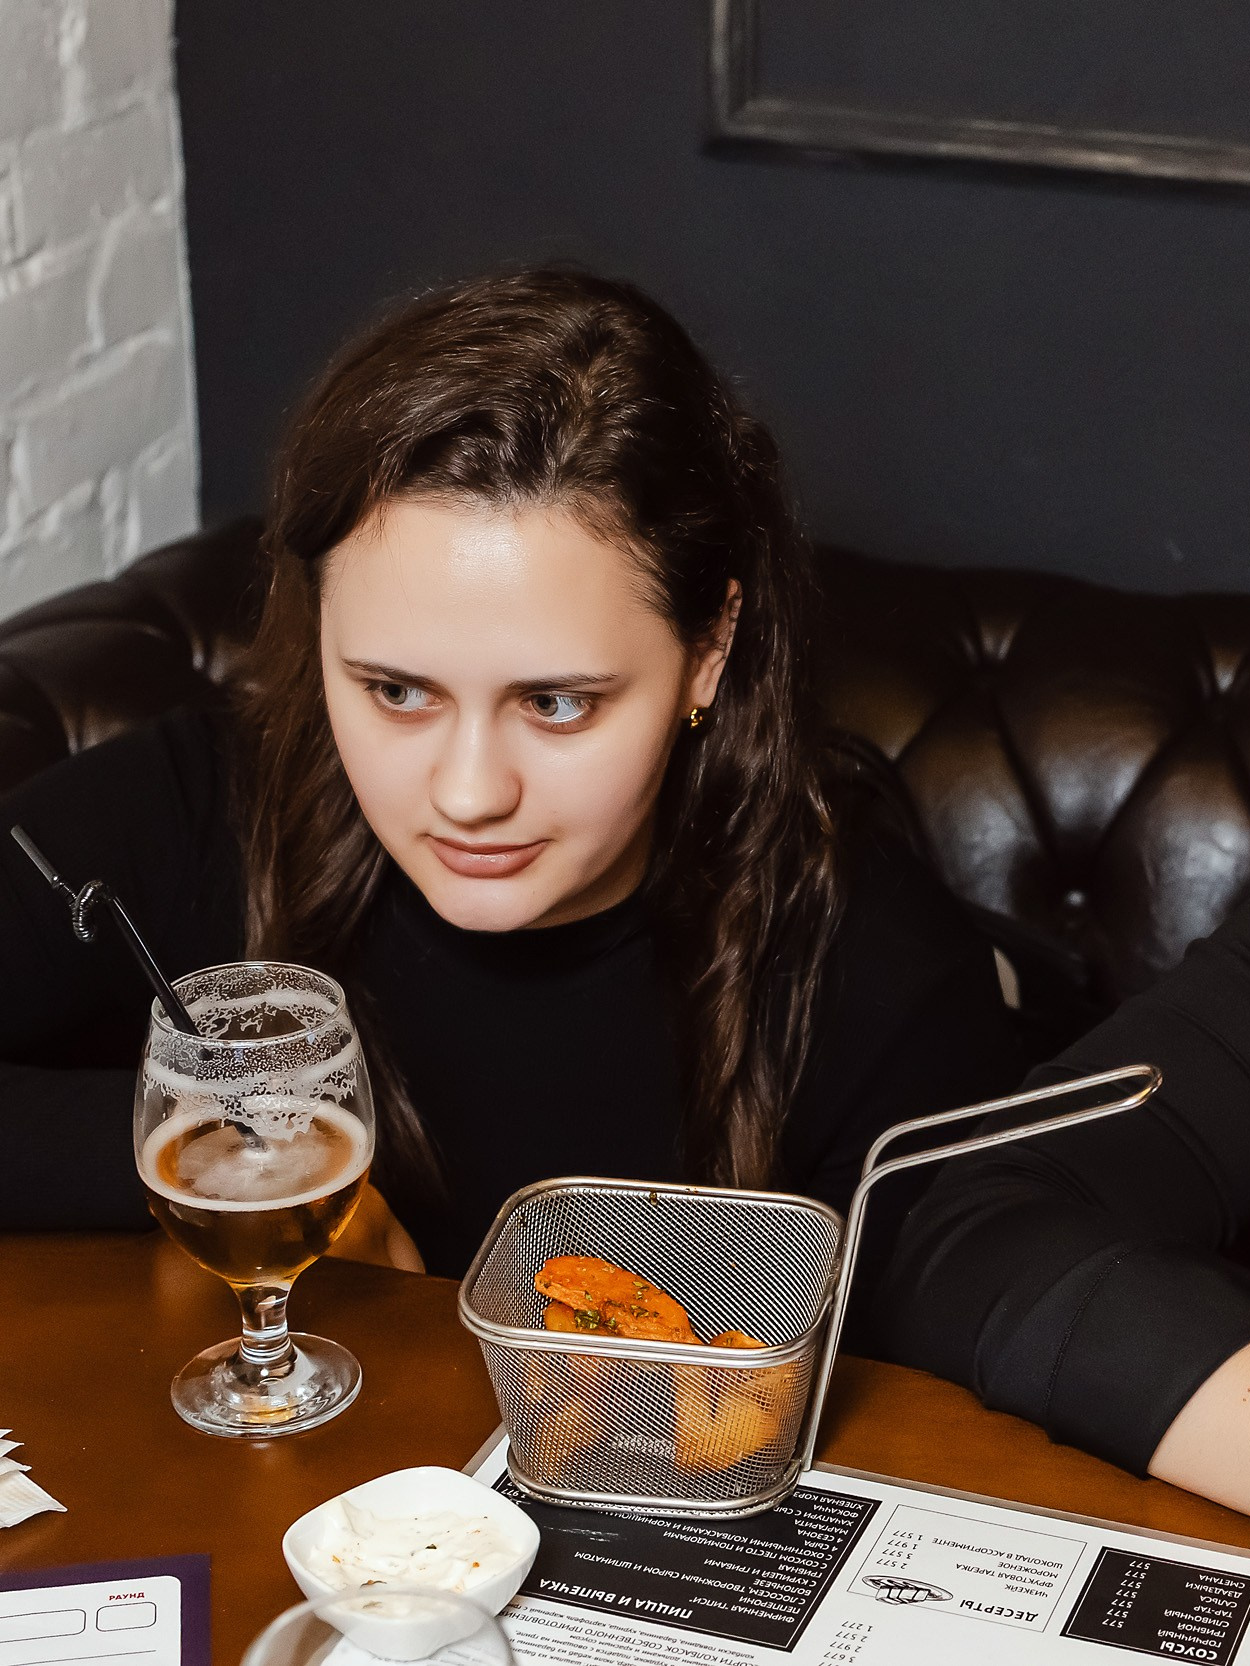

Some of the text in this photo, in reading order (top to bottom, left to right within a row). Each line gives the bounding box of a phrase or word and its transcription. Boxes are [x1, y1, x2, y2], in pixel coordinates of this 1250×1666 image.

[813, 1504, 859, 1518] ФОКАЧЧА
[819, 1496, 864, 1510] ХЛЕБНАЯ
[672, 1522, 681, 1530] И
[794, 1518, 849, 1535] МАРГАРИТА
[803, 1511, 854, 1527] ХАЧАПУРИ
[662, 1530, 735, 1550] ПОМИДОРАМИ
[681, 1525, 749, 1543] КОЛБАСКАМИ
[797, 1528, 835, 1542] СЕЗОНА
[892, 1530, 914, 1539] 577
[748, 1538, 825, 1559] ОХОТНИЧЬИМИ
[804, 1539, 830, 1550] СЫРА
[887, 1539, 908, 1548] 977
[931, 1537, 1005, 1557] АССОРТИМЕНТЕ
[574, 1551, 633, 1569] ШПИНАТОМ
[745, 1547, 778, 1559] ПЕСТО
[778, 1553, 819, 1568] СОУСОМ
[825, 1553, 833, 1561] С
[1014, 1553, 1063, 1569] ШОКОЛАД
[632, 1563, 642, 1571] И
[642, 1565, 680, 1579] СЫРОМ
[703, 1558, 751, 1573] ГРИБАМИ
[777, 1563, 823, 1578] ГРИБНАЯ
[882, 1548, 1054, 1588] ФРУКТОВАЯ ТАРЕЛКА 3 577
[997, 1561, 1059, 1579] МОРОЖЕНОЕ
[680, 1573, 745, 1593] ТВОРОЖНЫМ
[761, 1570, 809, 1585] КУРИЦЕЙ
[876, 1558, 1048, 1598] ЧИЗКЕЙК 2 577
[1129, 1560, 1246, 1589] СМЕТАНА 577
[752, 1578, 812, 1596] БОЛОНЬЕЗЕ
[1124, 1569, 1243, 1599] ДЗАДЗЫКИ 577
[108, 1591, 145, 1601] РАУНД
[539, 1578, 693, 1619] ПИЦЦА И ВЫПЕЧКА
[748, 1586, 799, 1603] ЛОСОСЕМ,
[1120, 1579, 1238, 1608] САЛЬСА 577
[738, 1595, 801, 1614] ПЕППЕРОНИ
[959, 1599, 1039, 1622] ДЕСЕРТЫ
[1115, 1589, 1232, 1618] ТАР-ТАР 577
[730, 1604, 795, 1623] ФИРМЕННАЯ
[1110, 1598, 1230, 1628] СЛИВОЧНЫЙ 577
[841, 1620, 863, 1630] 277
[1106, 1608, 1226, 1638] ГРИБНОЙ 577
[835, 1630, 868, 1643] 2 577
[1101, 1618, 1222, 1648] ГОРЧИЧНЫЙ 577
[829, 1641, 862, 1653] 2 977
[1159, 1640, 1218, 1660] СОУСЫ
[823, 1651, 846, 1661] 677
